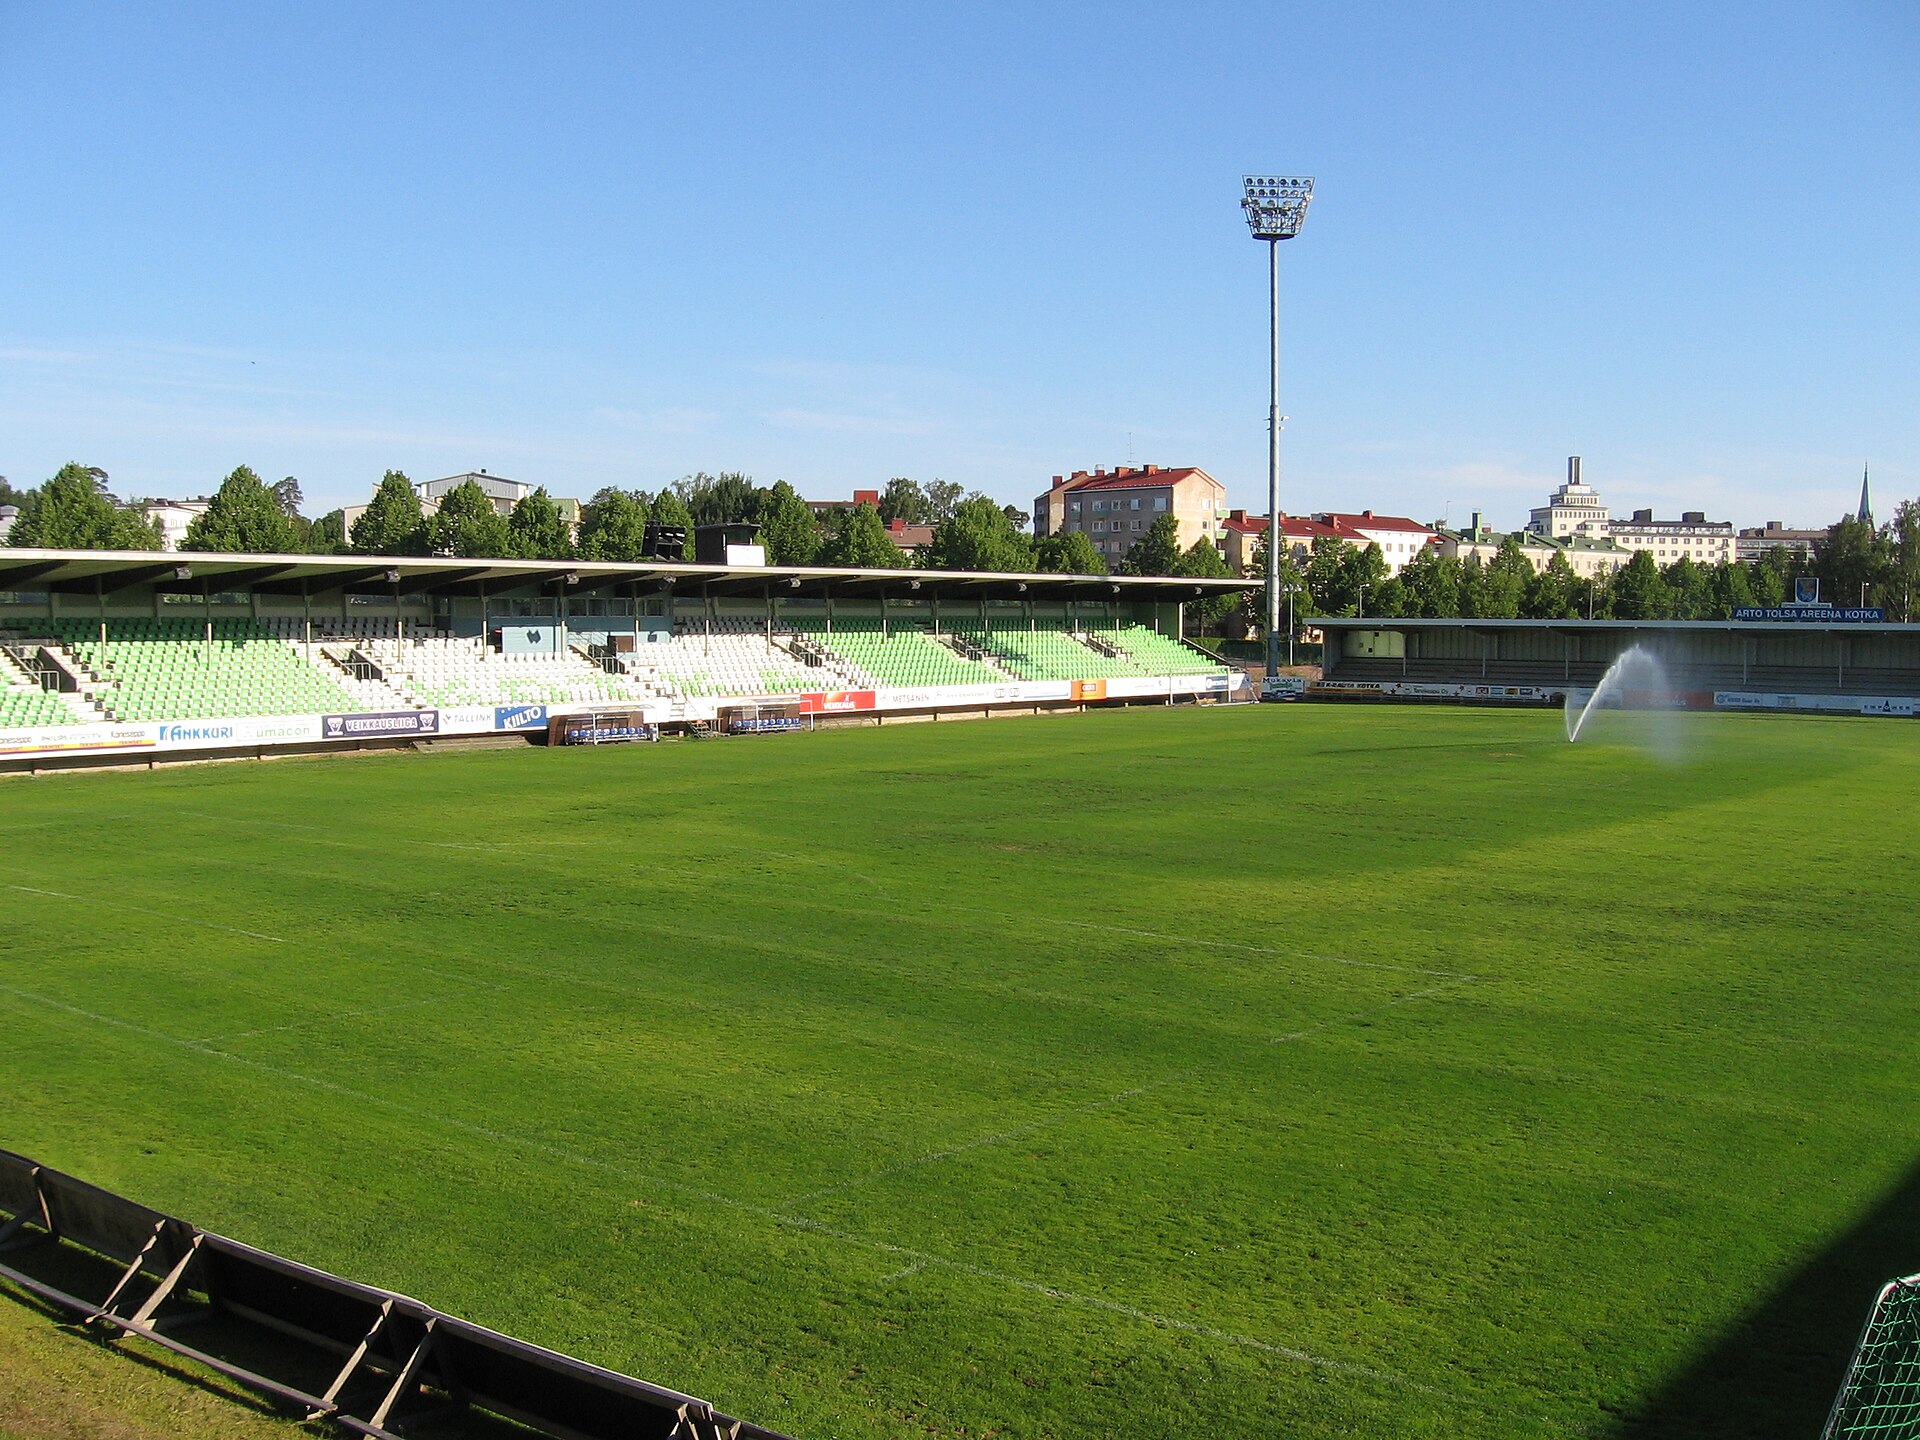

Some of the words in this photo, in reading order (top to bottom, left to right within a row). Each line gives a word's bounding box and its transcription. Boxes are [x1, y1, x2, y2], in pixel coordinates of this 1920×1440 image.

[1736, 609, 1763, 618] ARTO
[1765, 609, 1797, 618] TOLSA
[1800, 609, 1842, 619] AREENA
[1845, 610, 1879, 619] KOTKA
[454, 714, 492, 723] TALLINK
[503, 706, 541, 729] KIILTO
[345, 716, 418, 732] VEIKKAUSLIIGA
[256, 726, 310, 738] umacon
